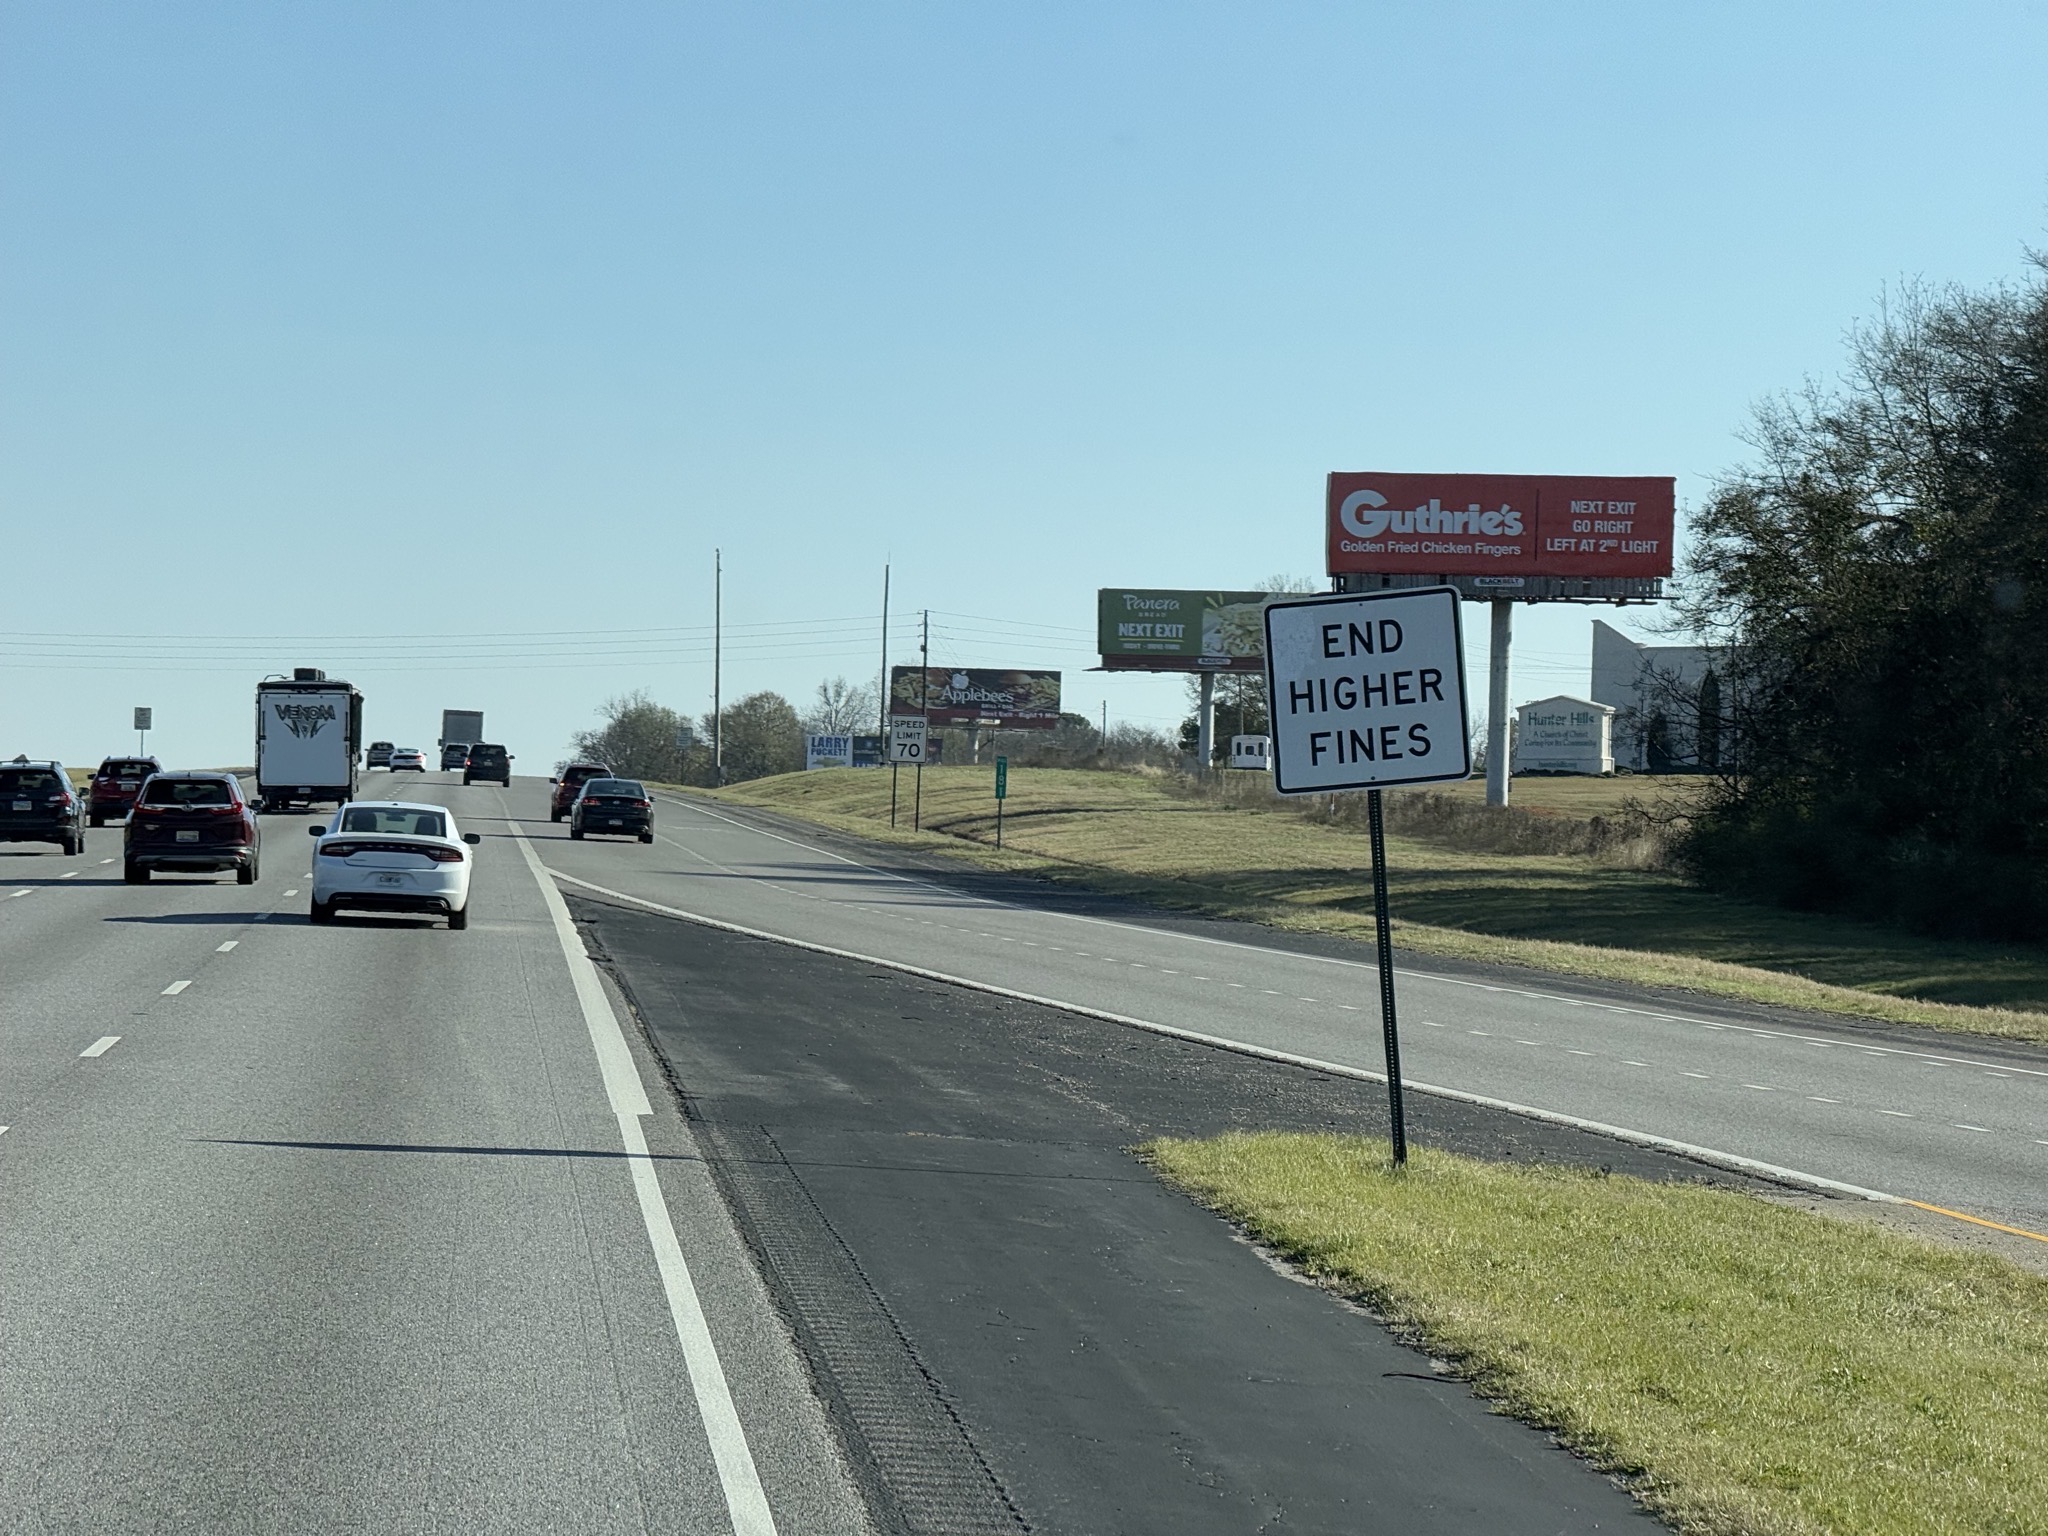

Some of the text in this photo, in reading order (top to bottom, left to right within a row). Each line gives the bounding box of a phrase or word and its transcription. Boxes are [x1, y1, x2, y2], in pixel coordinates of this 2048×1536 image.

[1340, 489, 1524, 538] Guthrie's
[1570, 500, 1637, 515] NEXT EXIT
[1573, 519, 1633, 534] GO RIGHT
[1340, 540, 1521, 557] Golden Fried Chicken Fingers
[1546, 538, 1577, 551] LEFT
[1579, 539, 1596, 552] AT
[1621, 540, 1659, 553] LIGHT
[1122, 593, 1180, 610] Panera
[1118, 622, 1185, 638] NEXT EXIT
[1321, 618, 1404, 659] END
[940, 684, 1014, 704] Applebee's
[1289, 668, 1444, 715] HIGHER
[274, 704, 336, 722] VENOM
[1528, 711, 1595, 726] Hunter Hills
[893, 720, 925, 729] SPEED
[811, 736, 849, 748] LARRY
[896, 732, 922, 740] LIMIT
[896, 743, 921, 758] 70
[1310, 722, 1431, 766] FINES
[810, 748, 848, 756] PUCKETT
